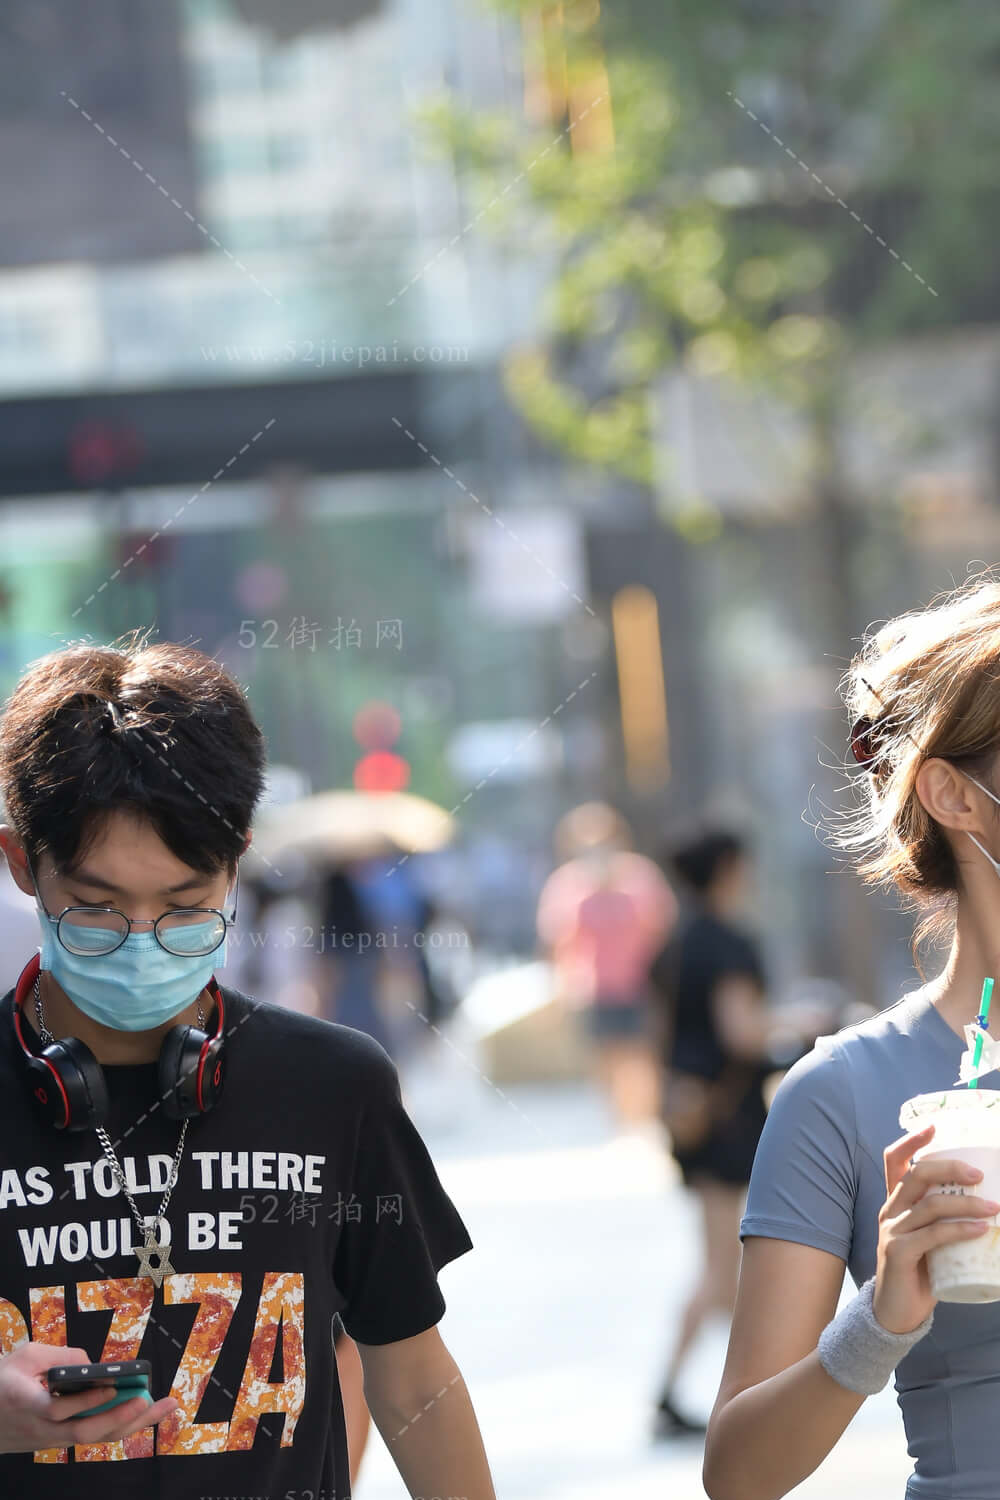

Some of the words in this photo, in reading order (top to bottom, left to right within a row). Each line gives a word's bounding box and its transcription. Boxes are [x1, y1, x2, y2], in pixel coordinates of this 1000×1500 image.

[64, 1154, 179, 1201] TOLD
[191, 1151, 326, 1194] THERE
[18, 1215, 172, 1267] WOULD
[188, 1211, 243, 1251] BE
